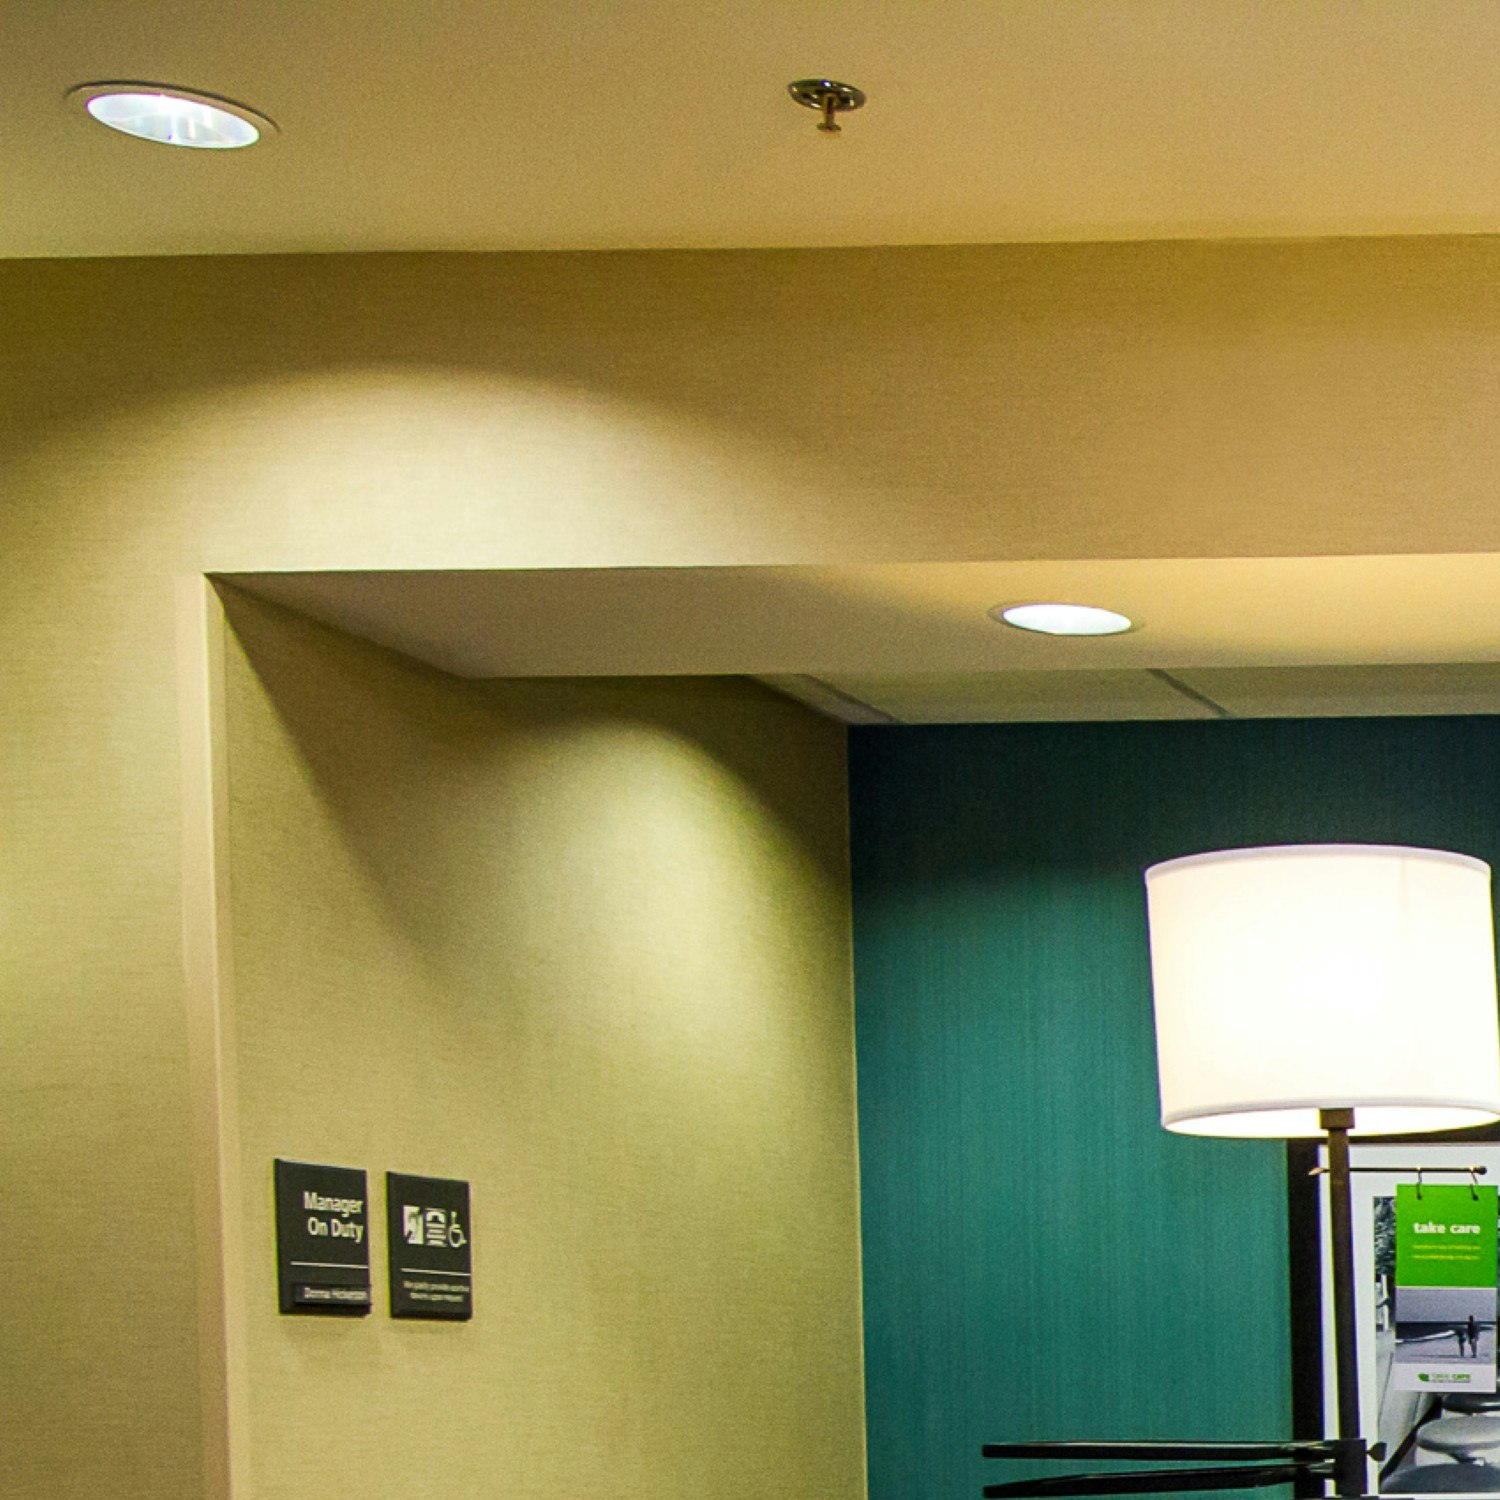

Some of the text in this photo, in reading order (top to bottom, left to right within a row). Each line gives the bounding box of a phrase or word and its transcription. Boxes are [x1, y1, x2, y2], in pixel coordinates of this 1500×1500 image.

[303, 1191, 364, 1218] Manager
[307, 1216, 364, 1243] On Duty
[1413, 1221, 1480, 1234] take care
